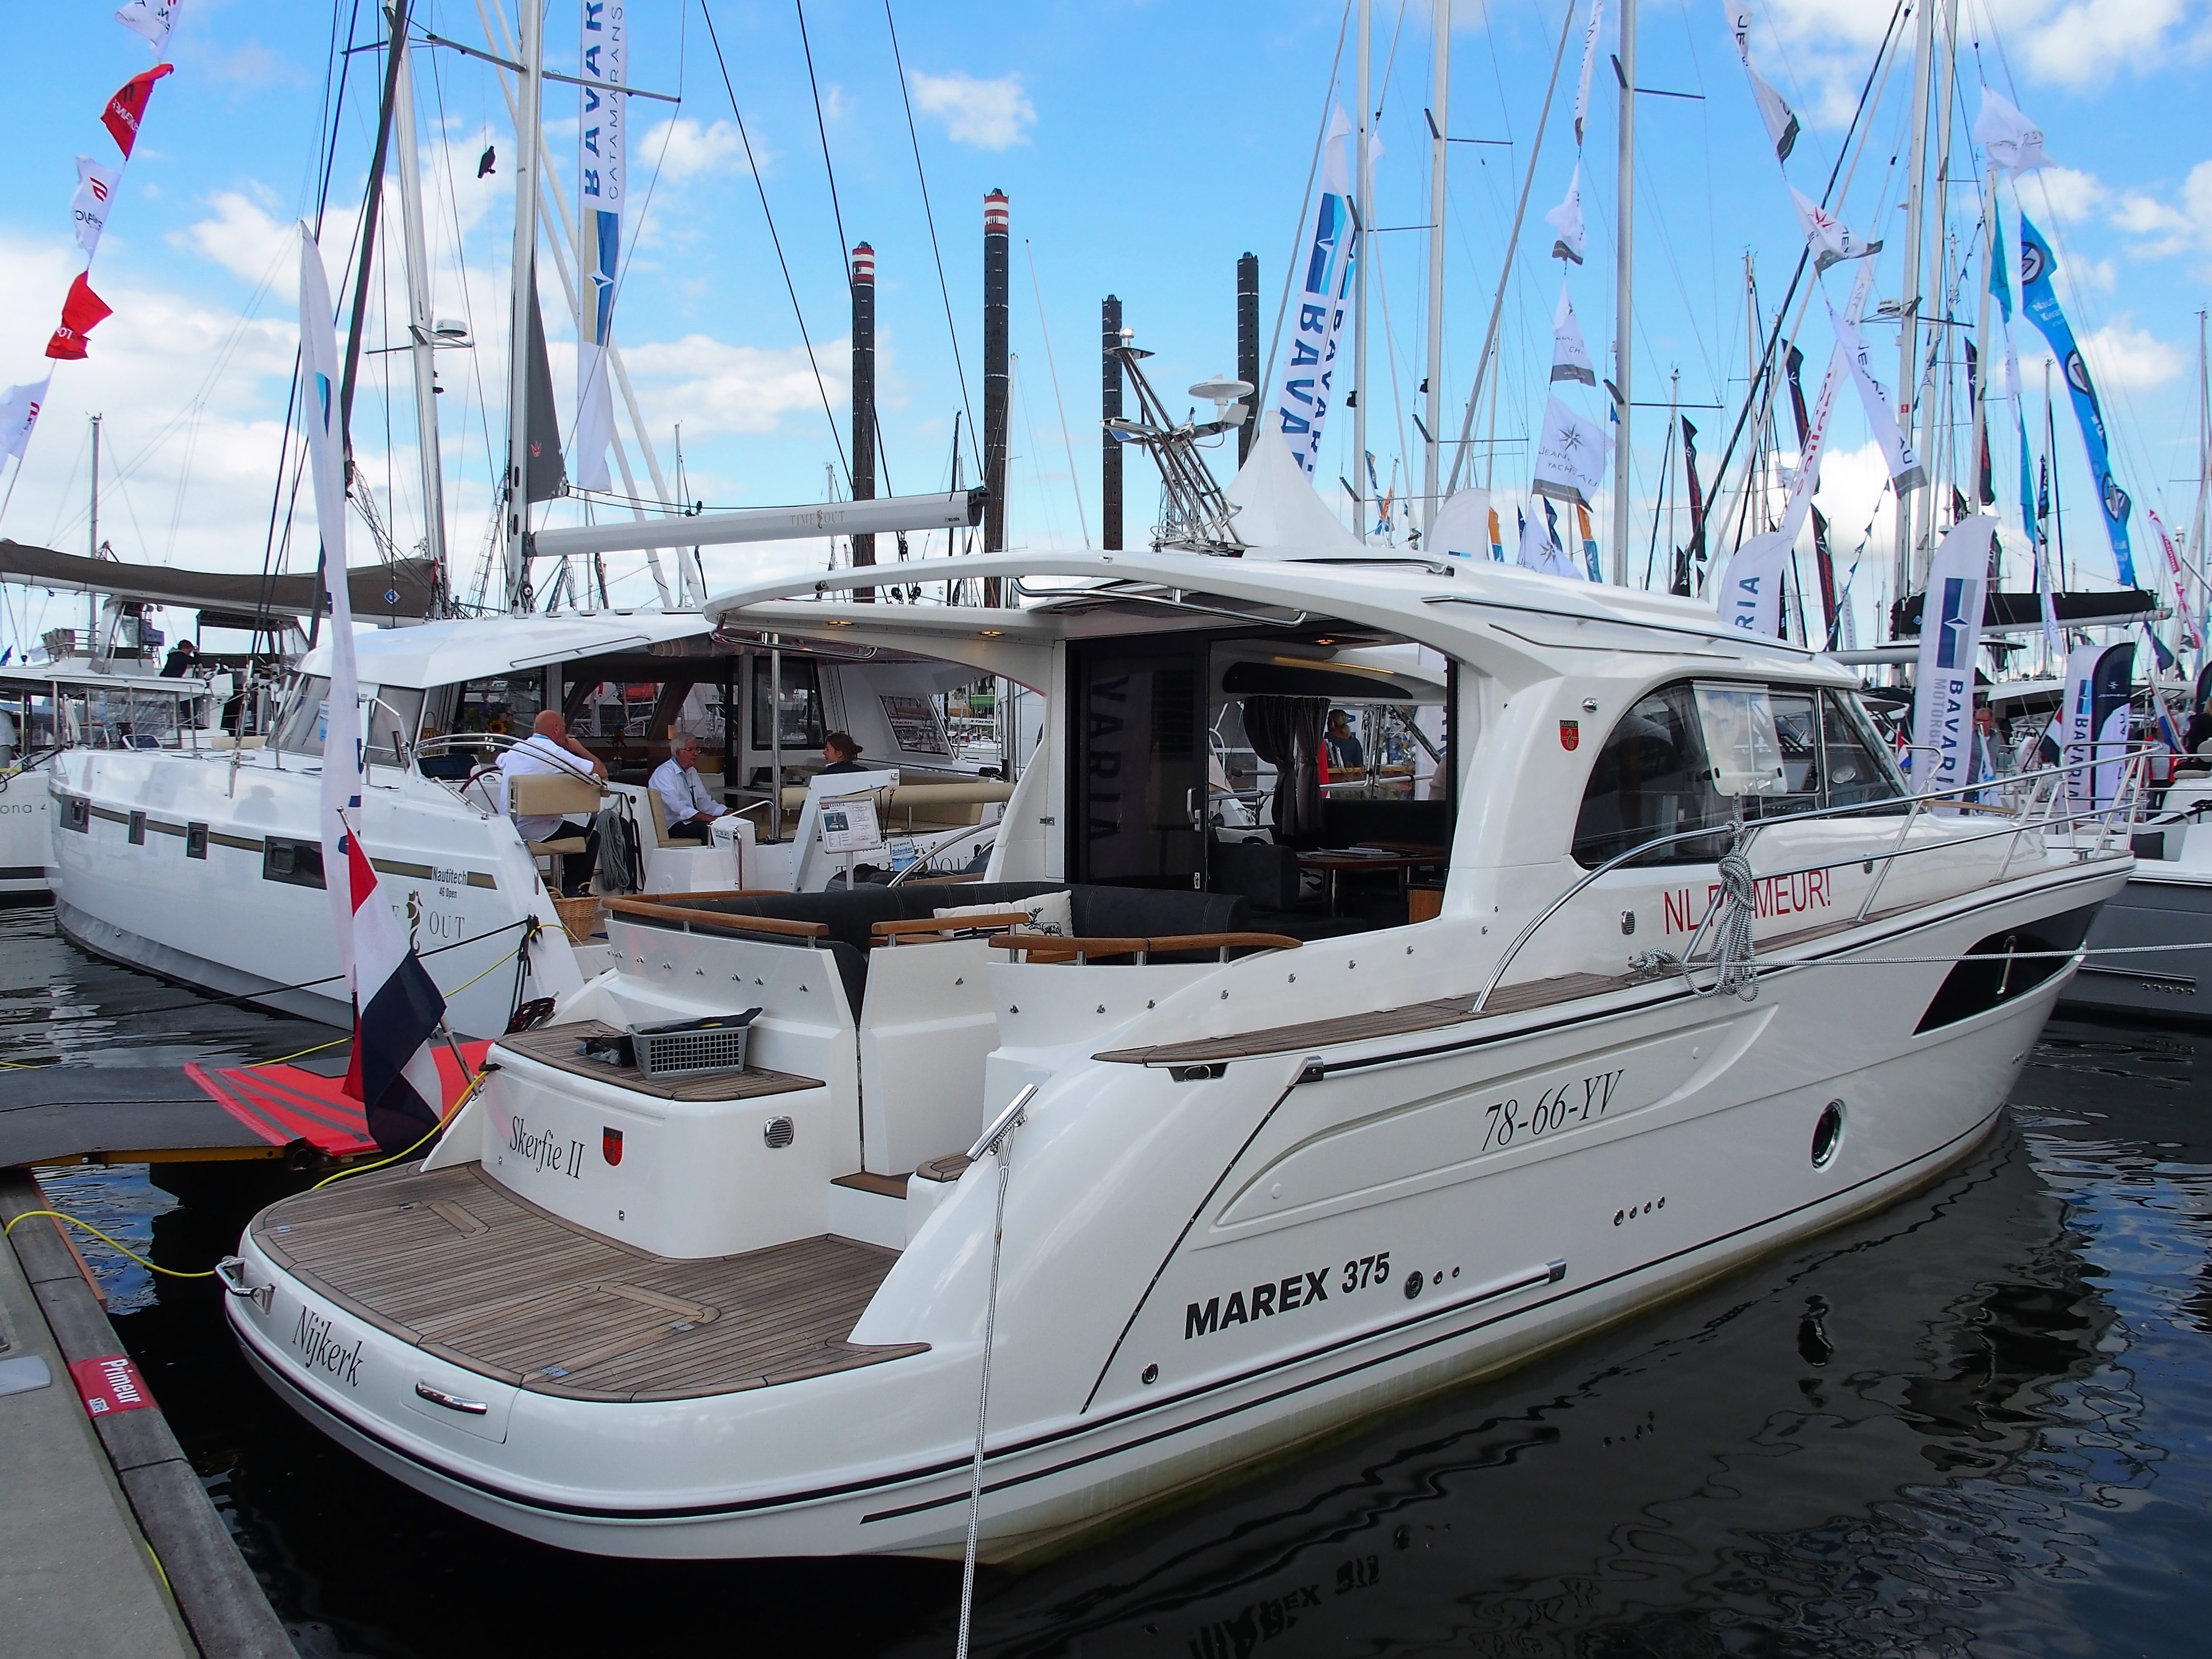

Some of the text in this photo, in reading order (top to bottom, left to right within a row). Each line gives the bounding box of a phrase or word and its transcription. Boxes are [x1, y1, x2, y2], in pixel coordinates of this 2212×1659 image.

[609, 7, 623, 200] CATAMARANS
[790, 511, 845, 526] TIME OUT
[433, 866, 467, 885] Nautitech
[1664, 869, 1831, 935] NL PMEUR!
[429, 911, 465, 939] OUT
[1482, 1069, 1624, 1152] 78-66-YV
[510, 1115, 586, 1180] Skerfie II
[1185, 1251, 1390, 1340] MAREX 375
[292, 1304, 364, 1388] Nijkerk
[100, 1358, 142, 1403] Primeur
